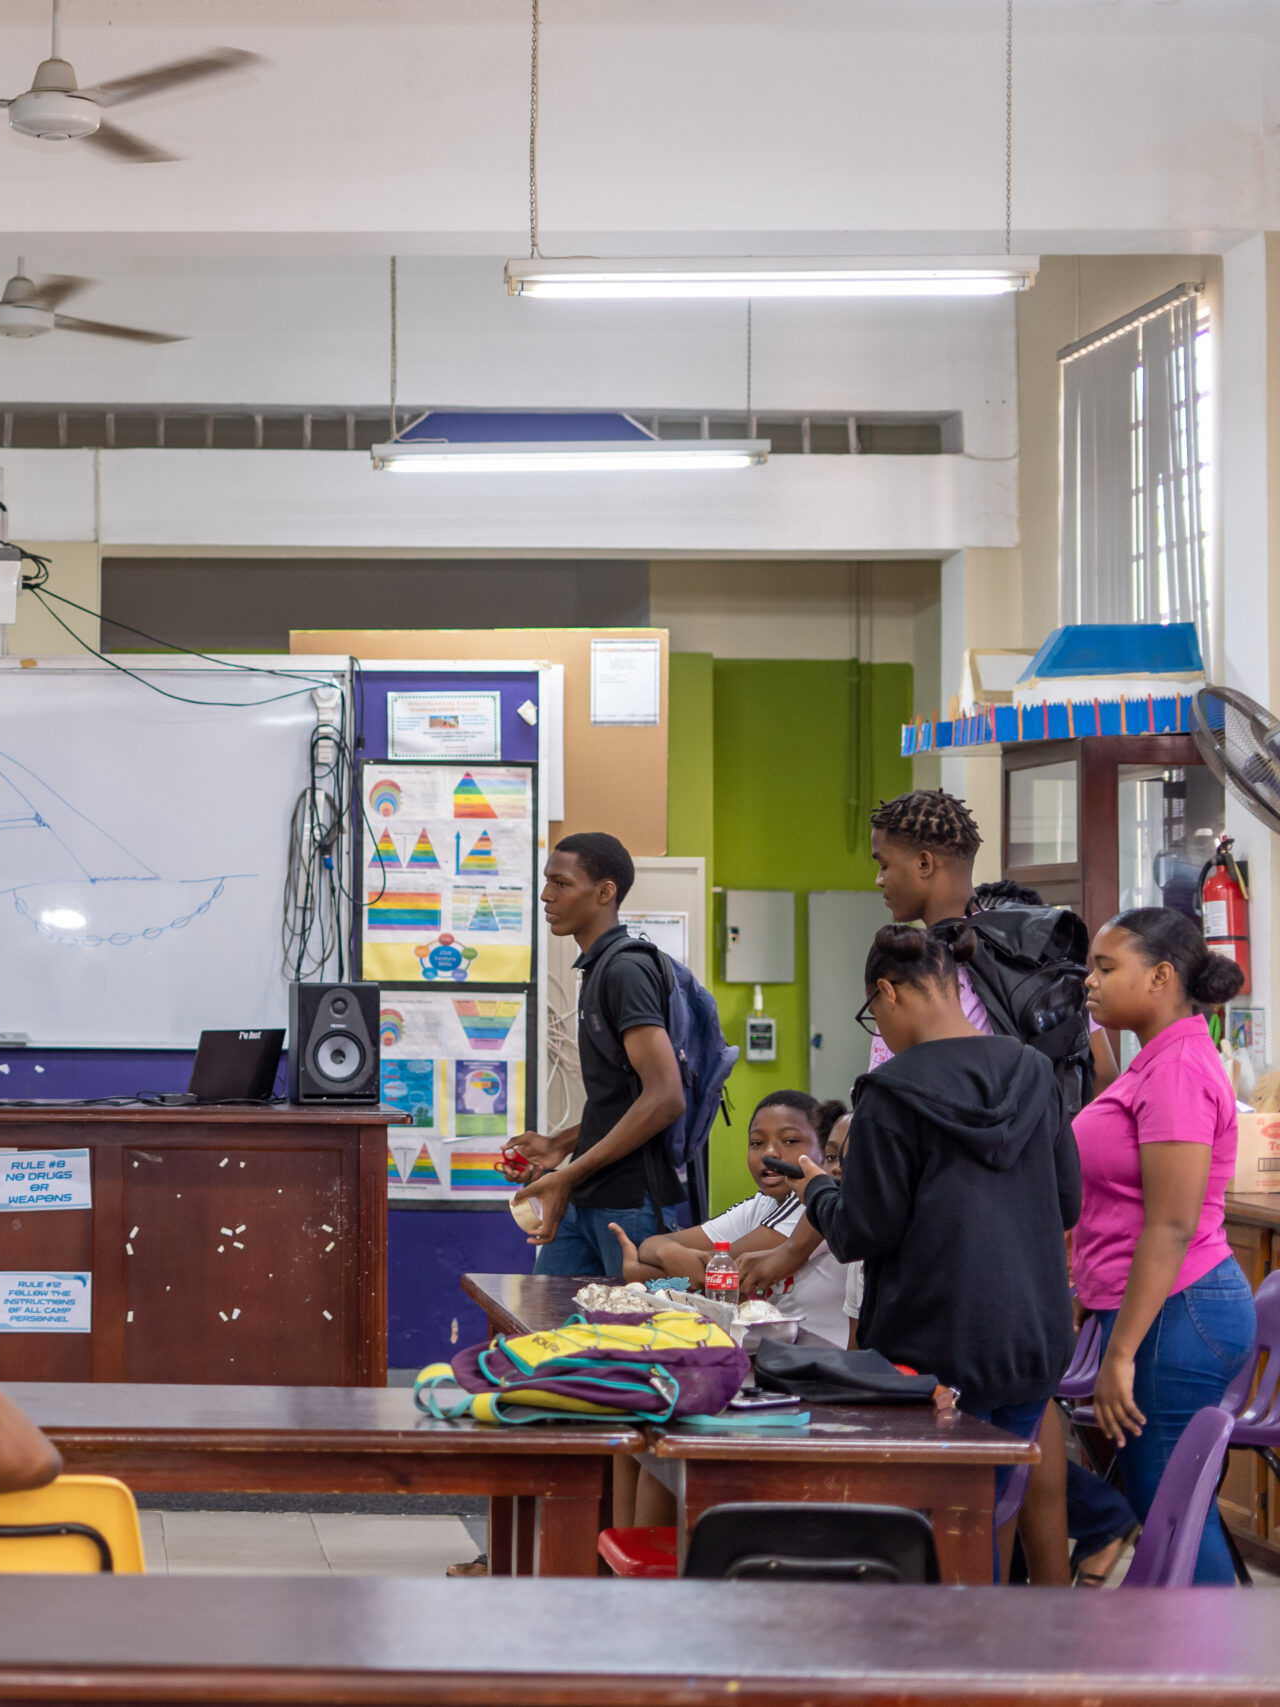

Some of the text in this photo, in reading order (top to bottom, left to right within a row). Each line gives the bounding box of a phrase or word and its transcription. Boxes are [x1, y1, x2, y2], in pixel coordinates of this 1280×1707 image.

[11, 1160, 66, 1170] RULE #8
[5, 1170, 73, 1182] NO DRUGS
[30, 1184, 49, 1192] OR
[8, 1194, 72, 1204] WEAPONS
[3, 1298, 76, 1306] INSTRUCTIONS
